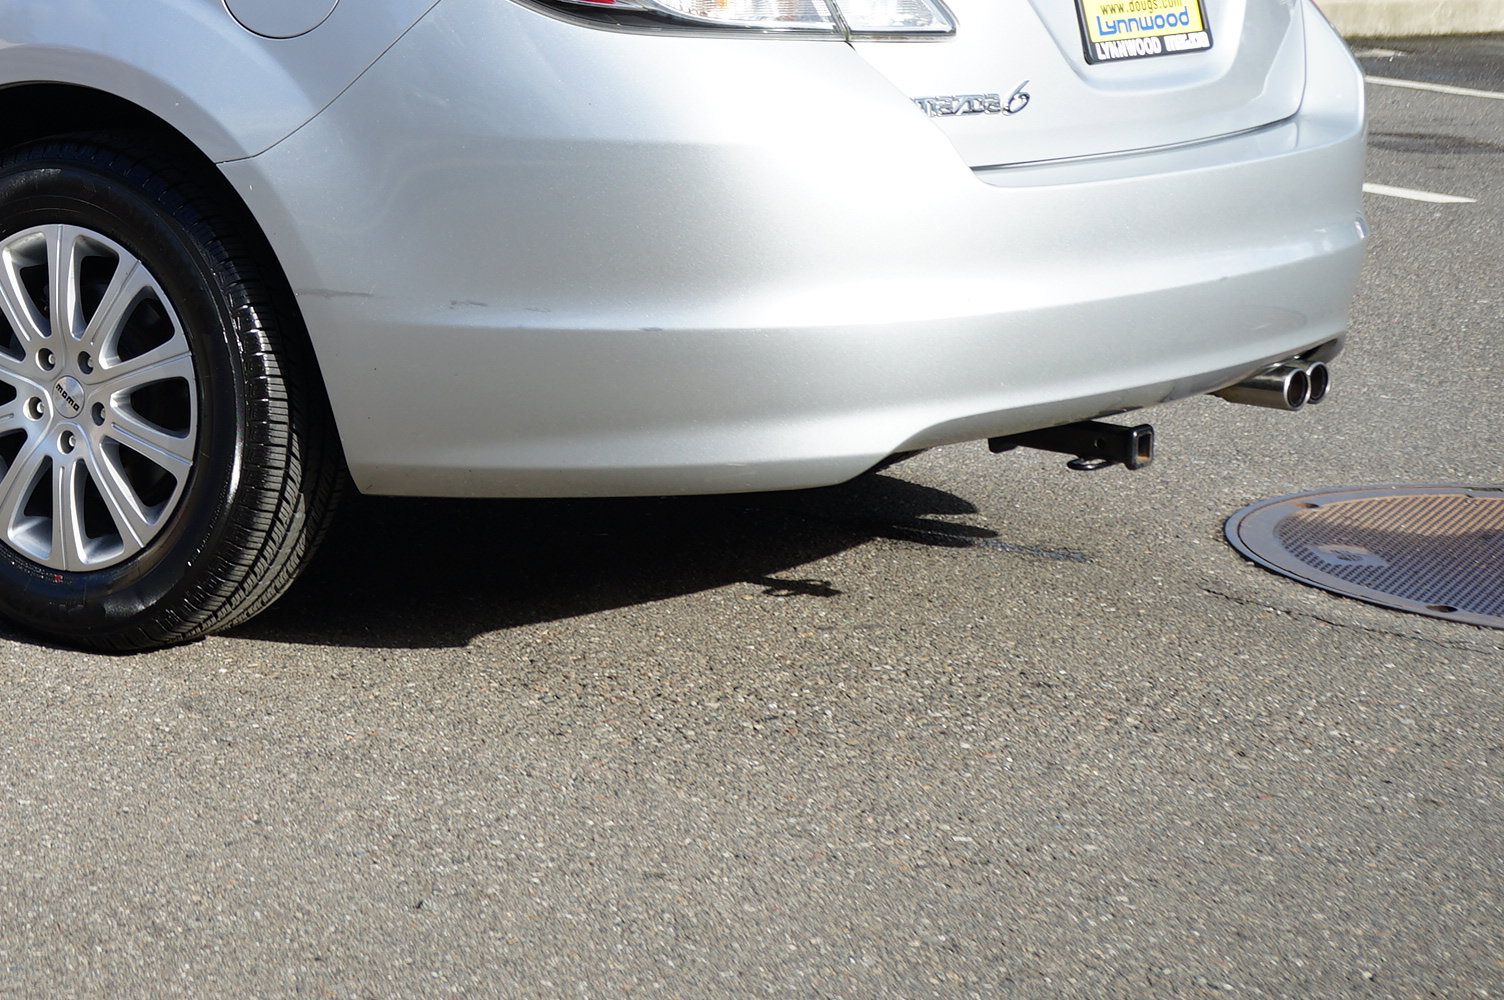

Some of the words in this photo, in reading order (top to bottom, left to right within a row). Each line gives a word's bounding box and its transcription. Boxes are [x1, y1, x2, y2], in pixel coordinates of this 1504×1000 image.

[1096, 6, 1190, 36] Lynnwood
[1095, 36, 1162, 60] LYNNWOOD
[55, 383, 80, 412] momo
